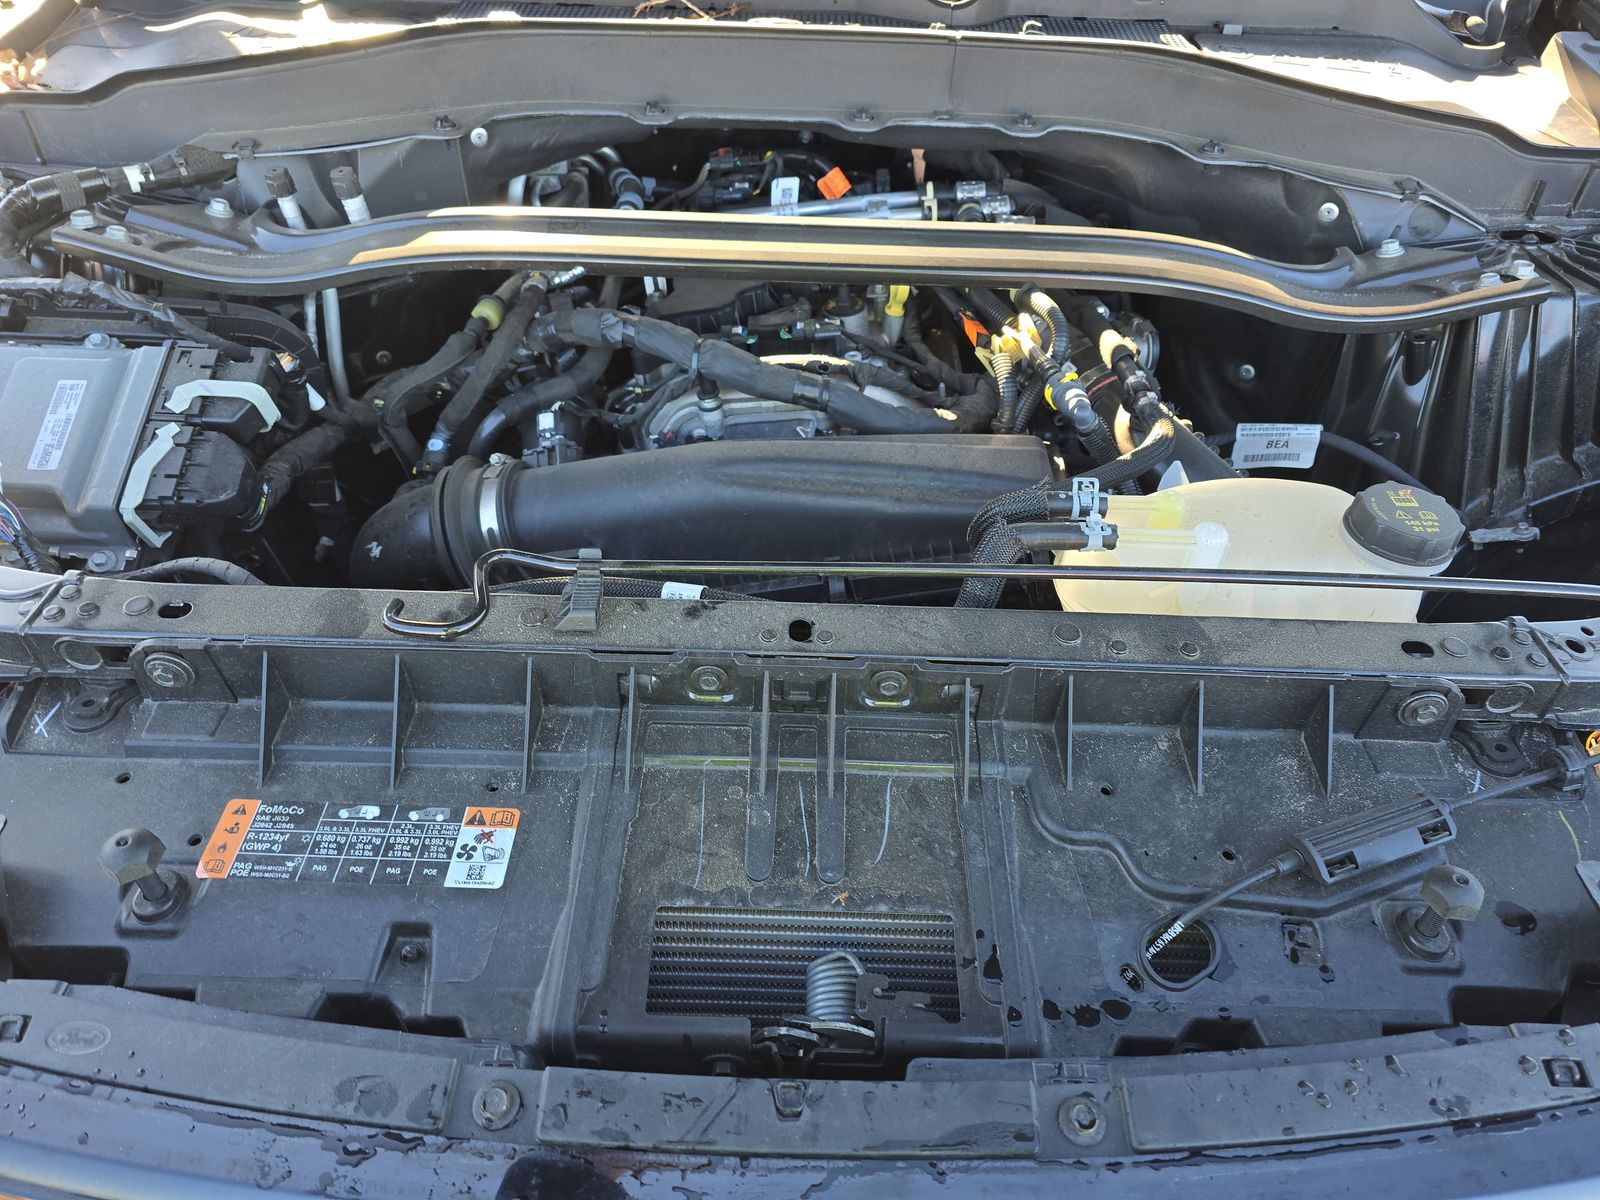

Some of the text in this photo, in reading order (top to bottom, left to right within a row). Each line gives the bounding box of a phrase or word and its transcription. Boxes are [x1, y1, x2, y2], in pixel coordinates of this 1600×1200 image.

[1266, 440, 1289, 449] BEA
[258, 804, 304, 815] FoMoCo
[246, 832, 290, 842] R-1234yf
[337, 835, 346, 844] kg
[372, 836, 381, 845] kg
[410, 837, 419, 846] kg
[242, 842, 282, 853] (GWP 4)
[445, 839, 454, 847] kg
[233, 862, 252, 870] PAG
